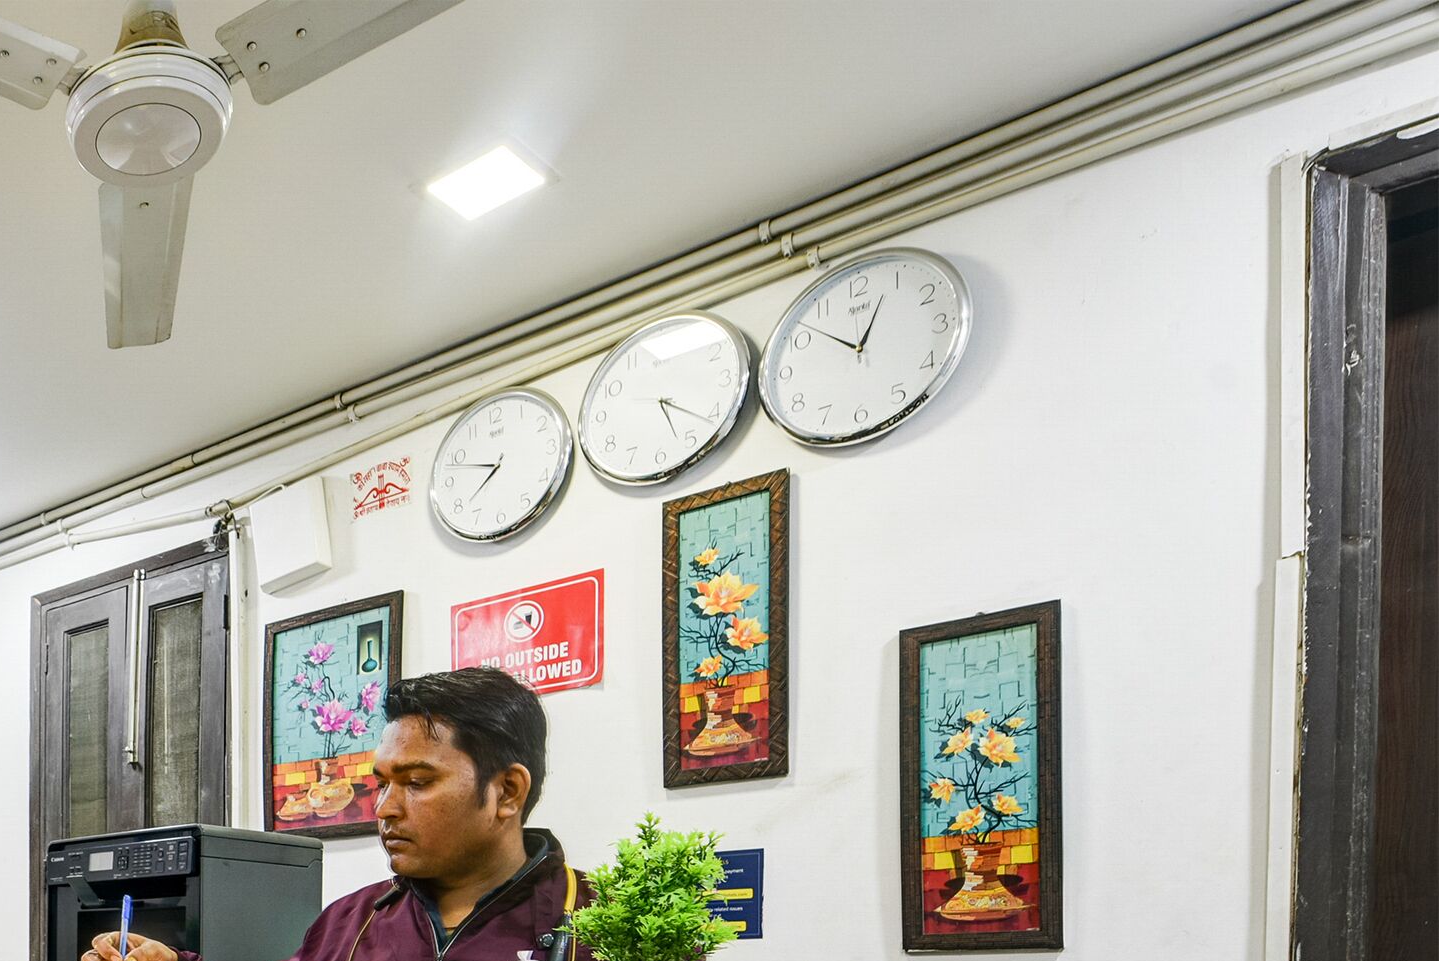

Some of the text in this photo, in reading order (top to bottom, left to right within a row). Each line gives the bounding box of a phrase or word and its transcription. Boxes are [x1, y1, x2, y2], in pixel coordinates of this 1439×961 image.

[849, 276, 868, 298] 12
[919, 283, 935, 306] 2
[817, 298, 829, 319] 11
[932, 313, 948, 334] 3
[790, 330, 811, 352] 10
[627, 351, 637, 370] 11
[709, 342, 721, 361] 2
[919, 350, 933, 370] 4
[717, 368, 731, 388] 3
[779, 365, 792, 384] 9
[604, 379, 623, 399] 10
[891, 383, 906, 404] 5
[707, 401, 719, 419] 4
[791, 392, 806, 412] 8
[489, 406, 503, 425] 12
[595, 409, 607, 427] 9
[818, 404, 833, 425] 7
[854, 404, 868, 424] 6
[467, 423, 478, 440] 11
[536, 415, 548, 433] 2
[545, 438, 557, 456] 3
[604, 434, 617, 453] 8
[684, 429, 697, 448] 5
[451, 449, 466, 465] 10
[625, 446, 638, 464] 7
[654, 449, 667, 465] 6
[444, 476, 454, 491] 9
[538, 467, 549, 483] 4
[453, 498, 463, 514] 8
[520, 491, 531, 510] 5
[472, 508, 482, 525] 7
[496, 508, 506, 524] 6
[481, 641, 568, 669] NO OUTSIDE
